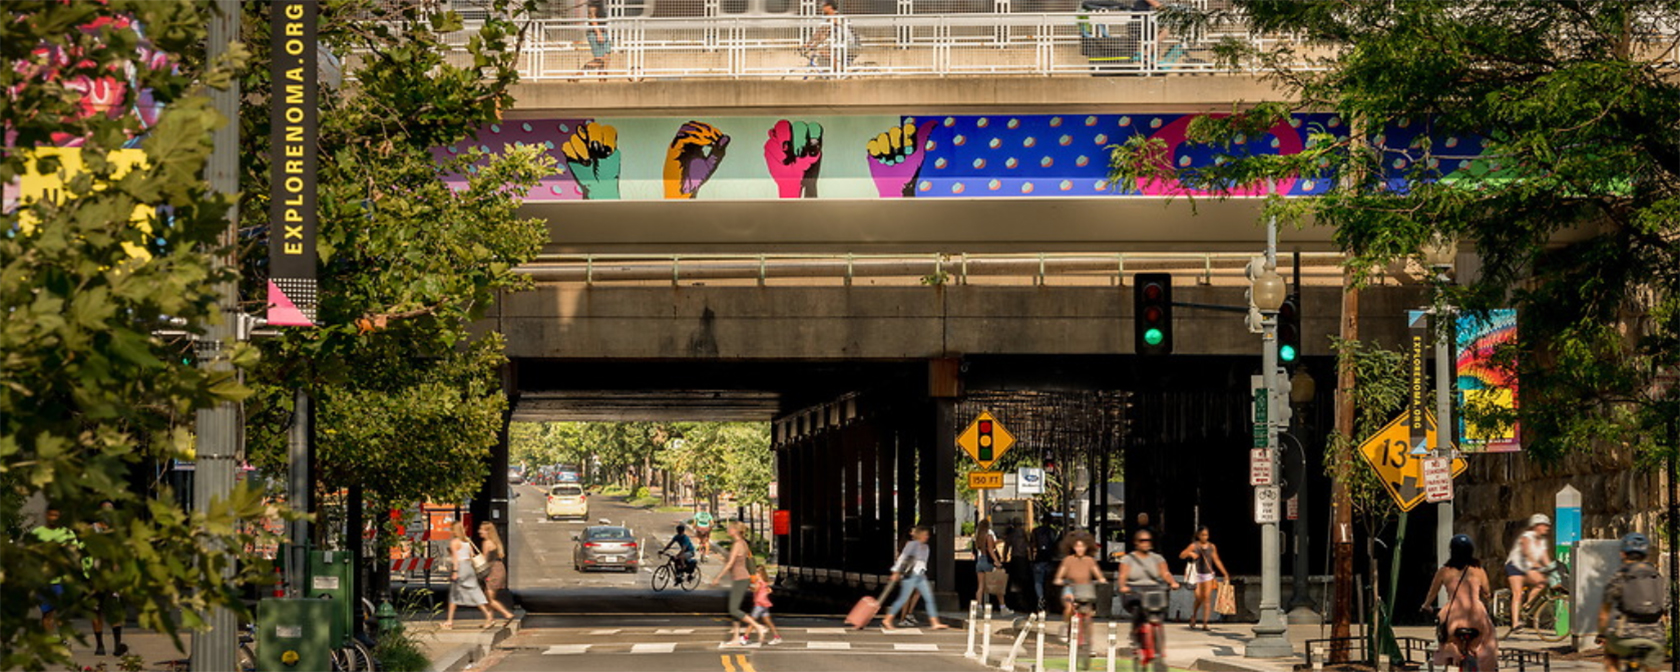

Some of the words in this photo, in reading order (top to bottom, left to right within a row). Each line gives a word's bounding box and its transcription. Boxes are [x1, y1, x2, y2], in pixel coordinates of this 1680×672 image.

[285, 3, 304, 255] EXPLORENOMA.ORG
[1412, 336, 1422, 429] EXPLORENOMA.ORG
[972, 476, 986, 484] 150
[990, 476, 999, 484] FT
